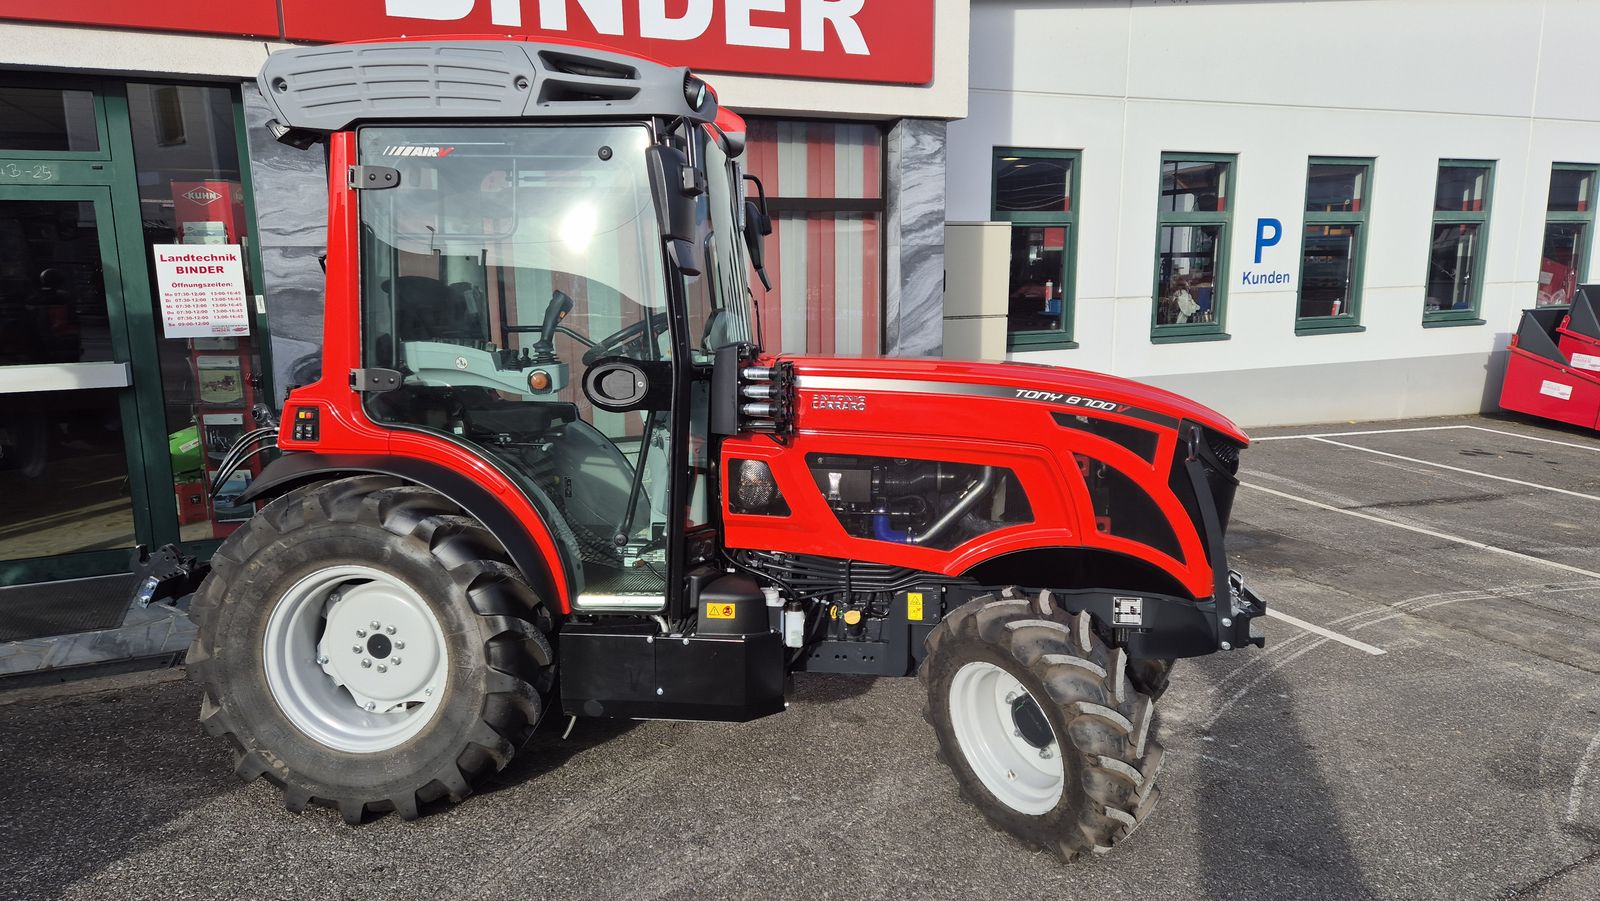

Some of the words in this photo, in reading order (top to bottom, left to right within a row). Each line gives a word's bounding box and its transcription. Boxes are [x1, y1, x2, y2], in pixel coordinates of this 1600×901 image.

[187, 192, 217, 200] KUHN
[1254, 218, 1282, 263] P
[160, 254, 237, 262] Landtechnik
[176, 266, 225, 274] BINDER
[1242, 271, 1290, 285] Kunden
[1015, 389, 1063, 402] TONY
[811, 401, 866, 411] CARRARO
